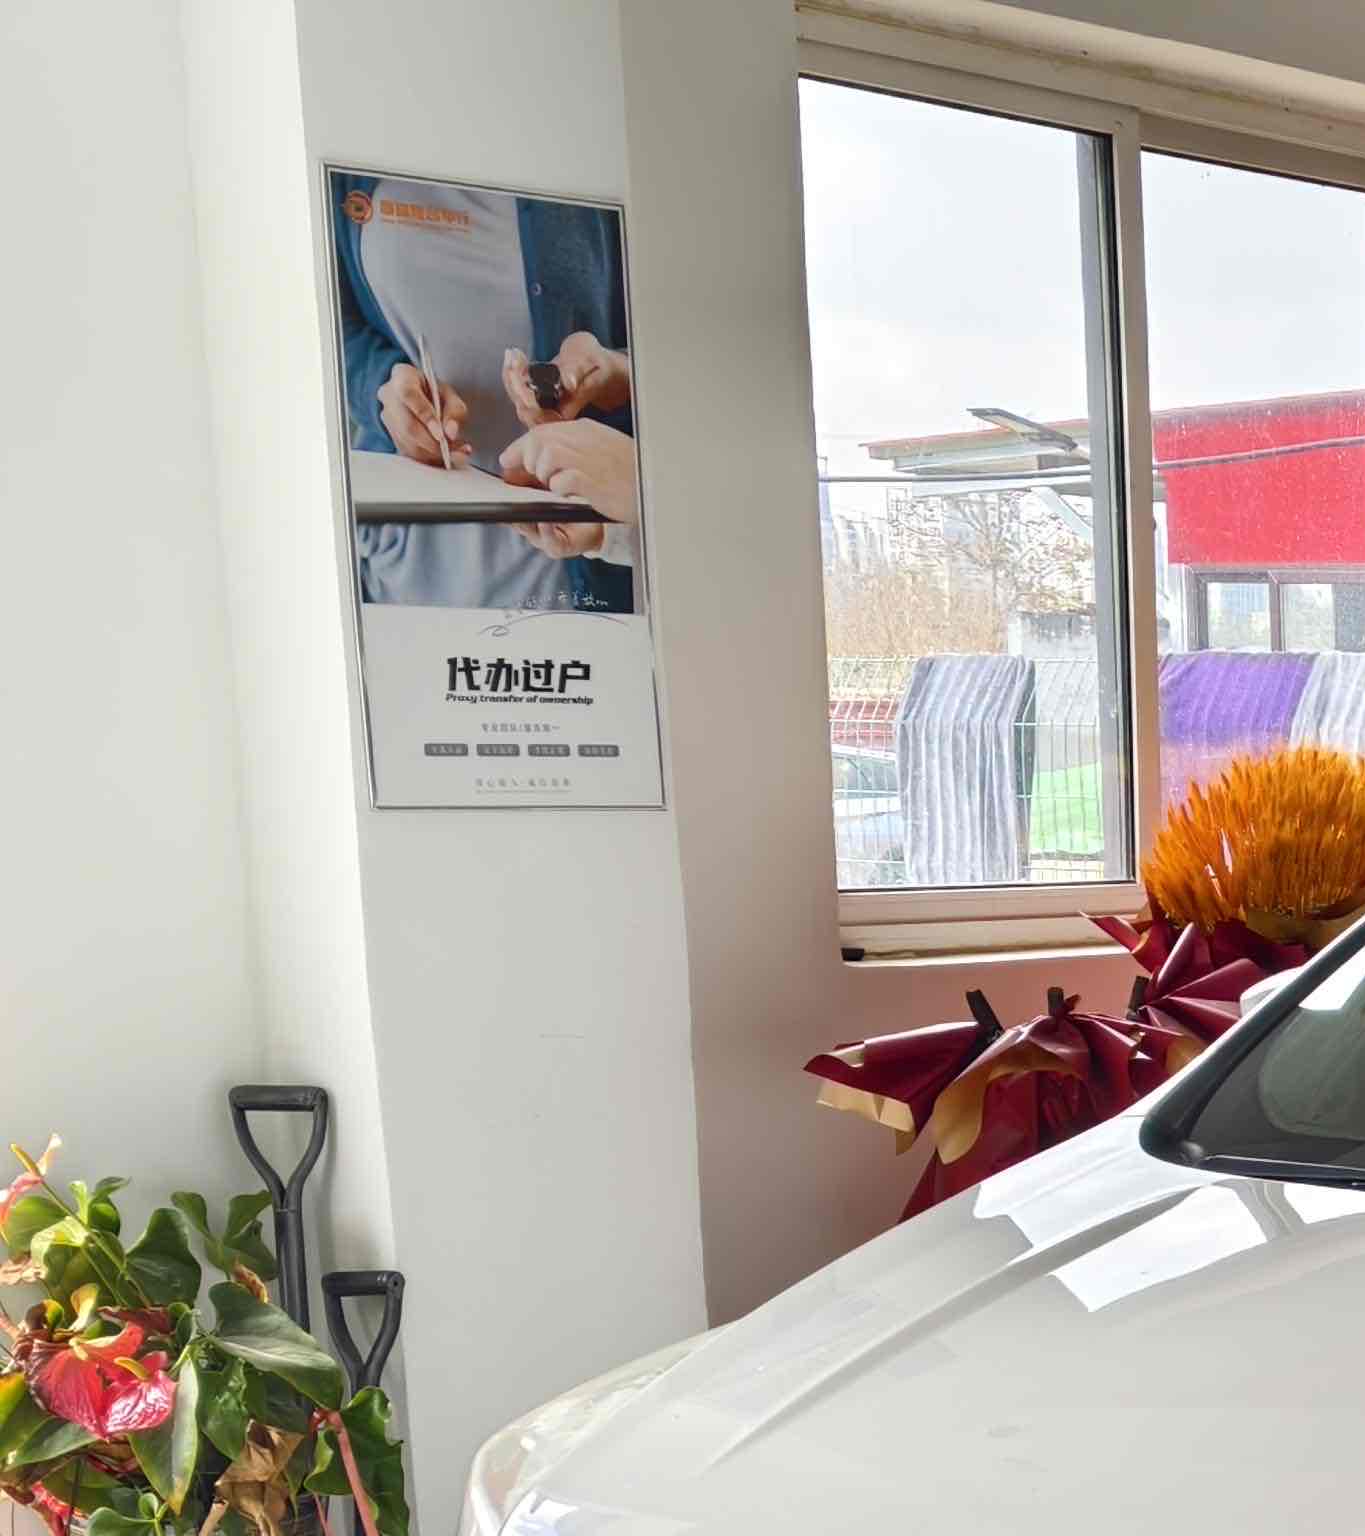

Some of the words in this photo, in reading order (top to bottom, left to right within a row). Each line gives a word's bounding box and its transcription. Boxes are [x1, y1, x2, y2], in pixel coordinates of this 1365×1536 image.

[447, 656, 591, 694] 代办过户
[446, 693, 477, 704] Proxy
[480, 694, 523, 703] transfer
[526, 695, 538, 703] of
[540, 696, 594, 705] ownership
